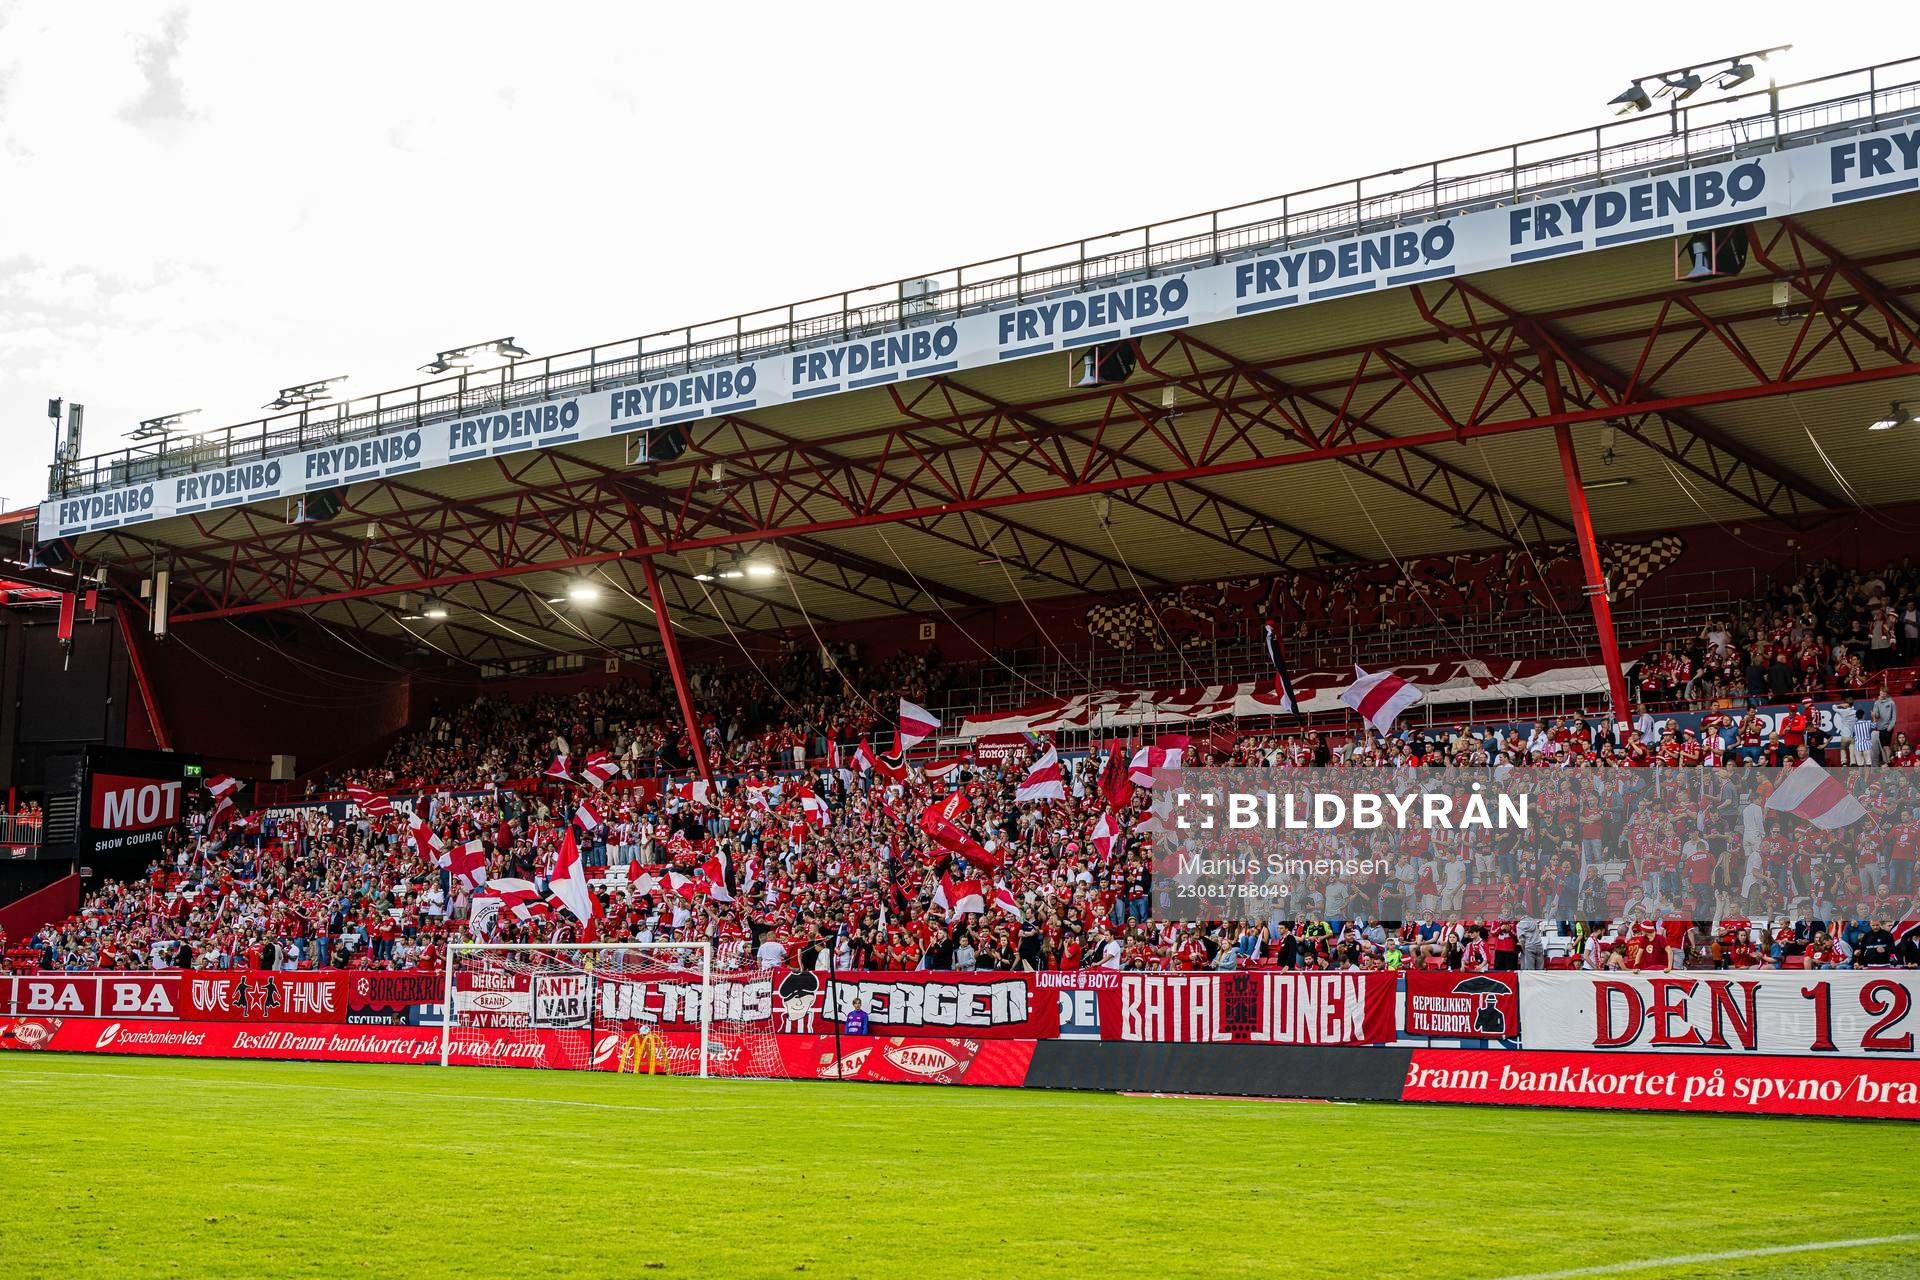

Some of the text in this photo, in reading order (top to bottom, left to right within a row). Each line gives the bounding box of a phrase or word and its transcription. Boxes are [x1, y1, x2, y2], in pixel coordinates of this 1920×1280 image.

[1509, 158, 1766, 246] FRYDENBØ
[1236, 219, 1455, 298] FRYDENBØ
[999, 274, 1189, 345] FRYDENBØ
[792, 322, 958, 386] FRYDENBØ
[610, 362, 757, 420] FRYDENBØ
[449, 398, 580, 450] FRYDENBØ
[305, 429, 421, 479] FRYDENBØ
[176, 458, 281, 503] FRYDENBØ
[59, 483, 154, 526] FRYDENBØ
[924, 625, 931, 638] B
[102, 781, 182, 830] MOT
[95, 838, 123, 851] SHOW
[471, 974, 516, 989] BERGEN
[538, 977, 584, 998] ANTI-
[1036, 973, 1118, 988] LOUNGE BOYZ
[27, 983, 84, 1011] BA
[112, 983, 174, 1012] BA
[480, 997, 505, 1006] BRANN
[543, 998, 578, 1016] VAR
[822, 979, 1028, 1026] BERGEN
[1413, 995, 1472, 1013] REPUBLIKKEN
[472, 1014, 488, 1027] AV
[1413, 1013, 1472, 1033] TIL EUROPA
[1592, 979, 1915, 1052] DEN 12
[232, 1031, 281, 1049] Bestill
[279, 1032, 416, 1055] Brann-bankkortet
[414, 1036, 439, 1059] på
[963, 1039, 979, 1053] VISA
[900, 1051, 946, 1068] BRANN
[1404, 1062, 1677, 1095] Brann-bankkortet
[1680, 1068, 1725, 1103] på
